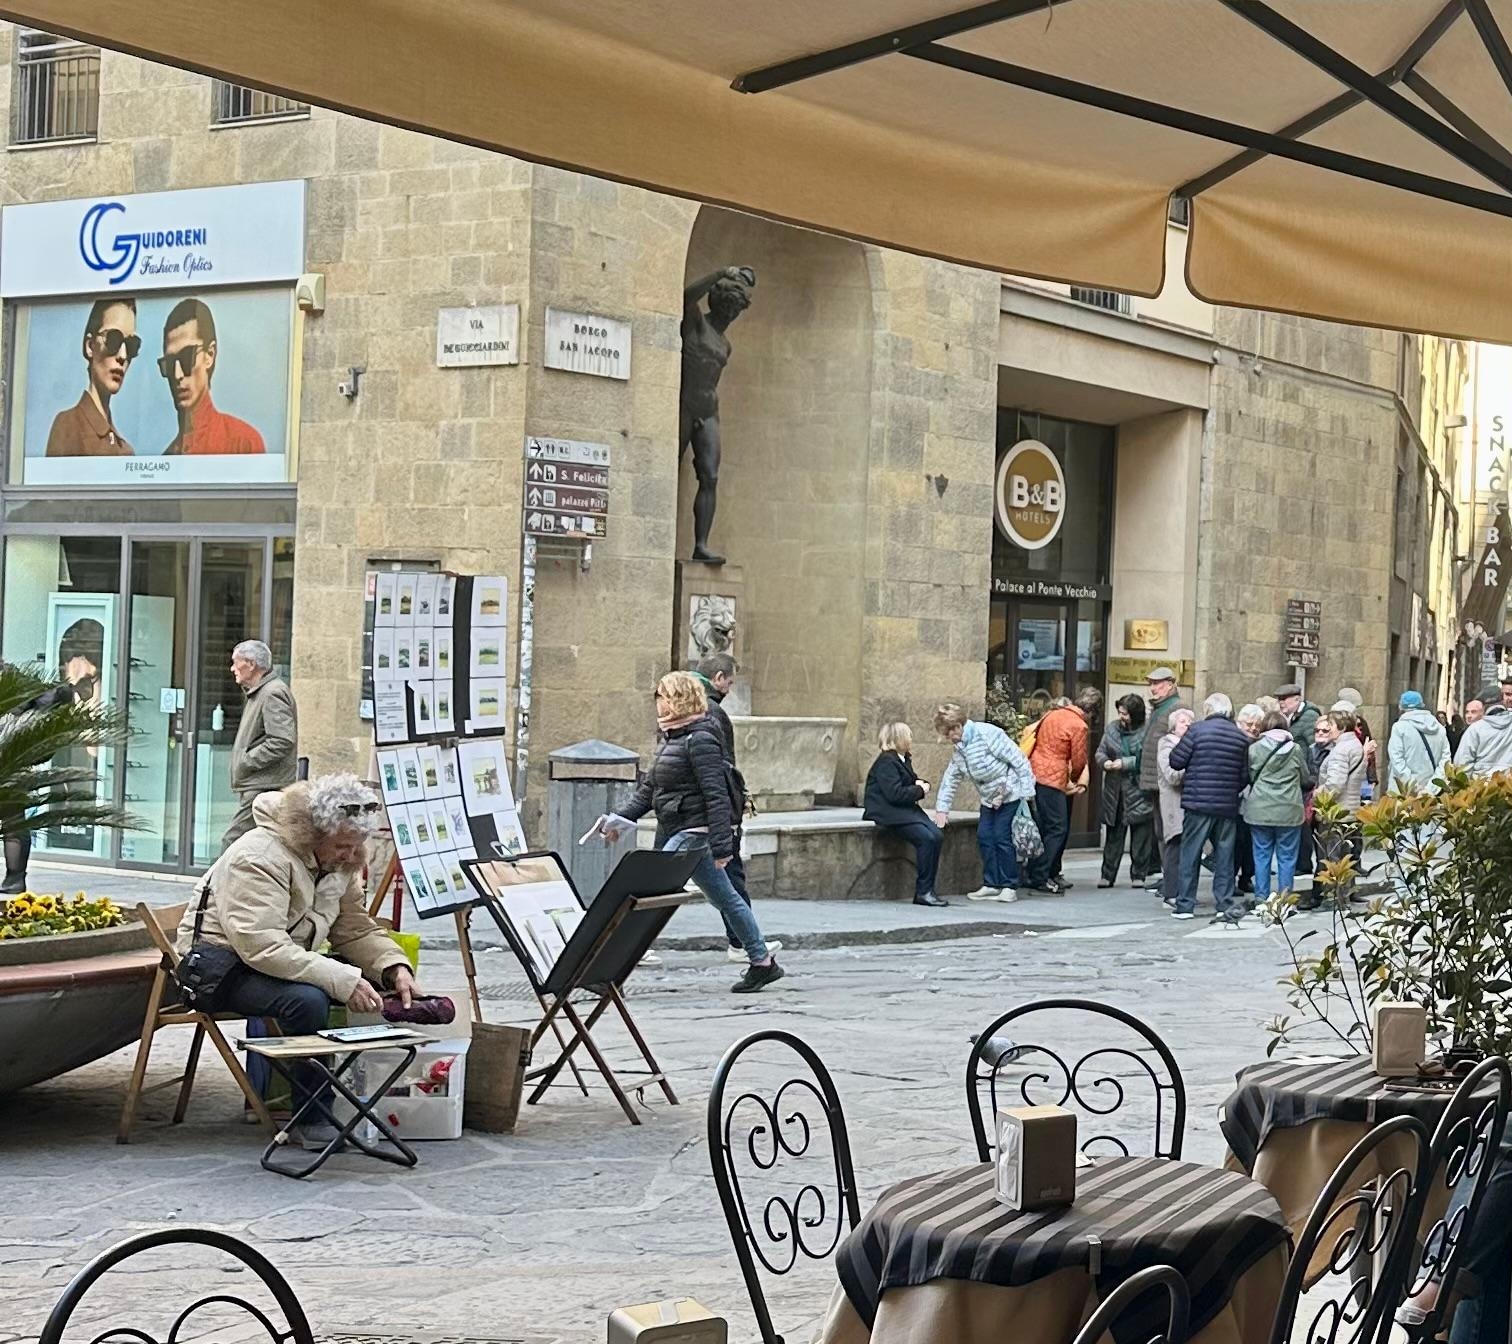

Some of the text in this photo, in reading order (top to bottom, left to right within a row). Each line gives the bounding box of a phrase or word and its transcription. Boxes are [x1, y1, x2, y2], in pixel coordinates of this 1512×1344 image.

[140, 253, 213, 279] Fashion Optics
[470, 320, 484, 330] VIA
[574, 324, 608, 338] BORGO
[560, 340, 620, 359] SAN IACOPO
[125, 462, 170, 471] FERRAGAMO
[1488, 415, 1505, 516] SNACK
[561, 469, 570, 481] S.
[1010, 474, 1062, 513] B&B
[561, 496, 589, 508] palazzo
[1015, 511, 1051, 525] HOTELS
[1484, 526, 1502, 587] BAR
[995, 578, 1097, 599] Palace al Ponte Vecchio
